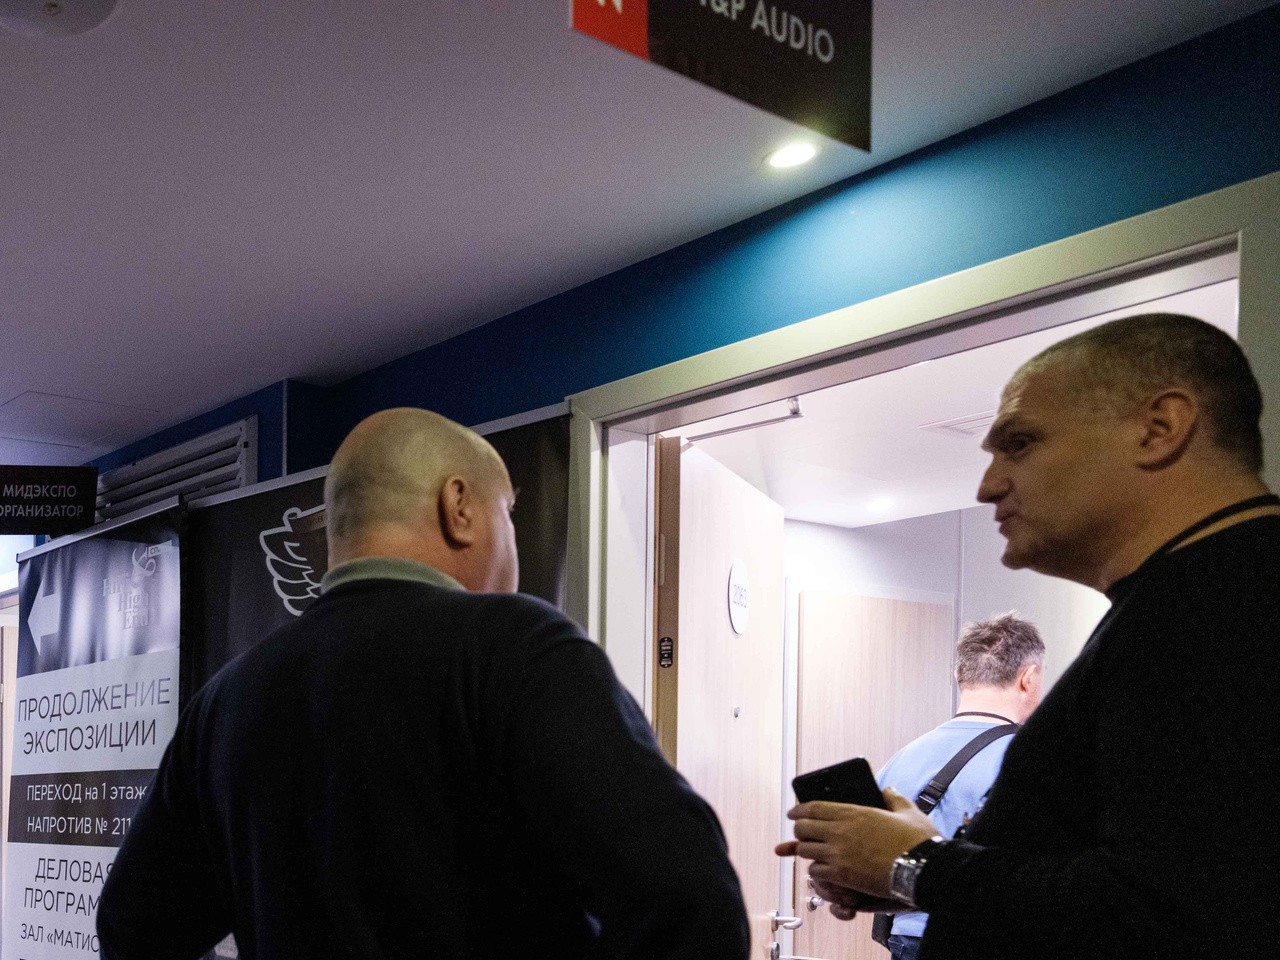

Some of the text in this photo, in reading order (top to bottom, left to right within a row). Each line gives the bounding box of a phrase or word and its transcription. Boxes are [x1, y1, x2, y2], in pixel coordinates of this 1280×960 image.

[750, 0, 835, 63] AUDIO
[3, 484, 77, 499] МИДЭКСПО
[18, 677, 171, 722] ПРОДОЛЖЕНИЕ
[23, 719, 156, 755] ЭКСПОЗИЦИИ
[26, 782, 148, 803] ПЕРЕХОД на 1 этаж
[27, 816, 92, 834] НАПРОТИВ
[95, 817, 108, 834] №
[20, 922, 44, 943] ЗАЛ
